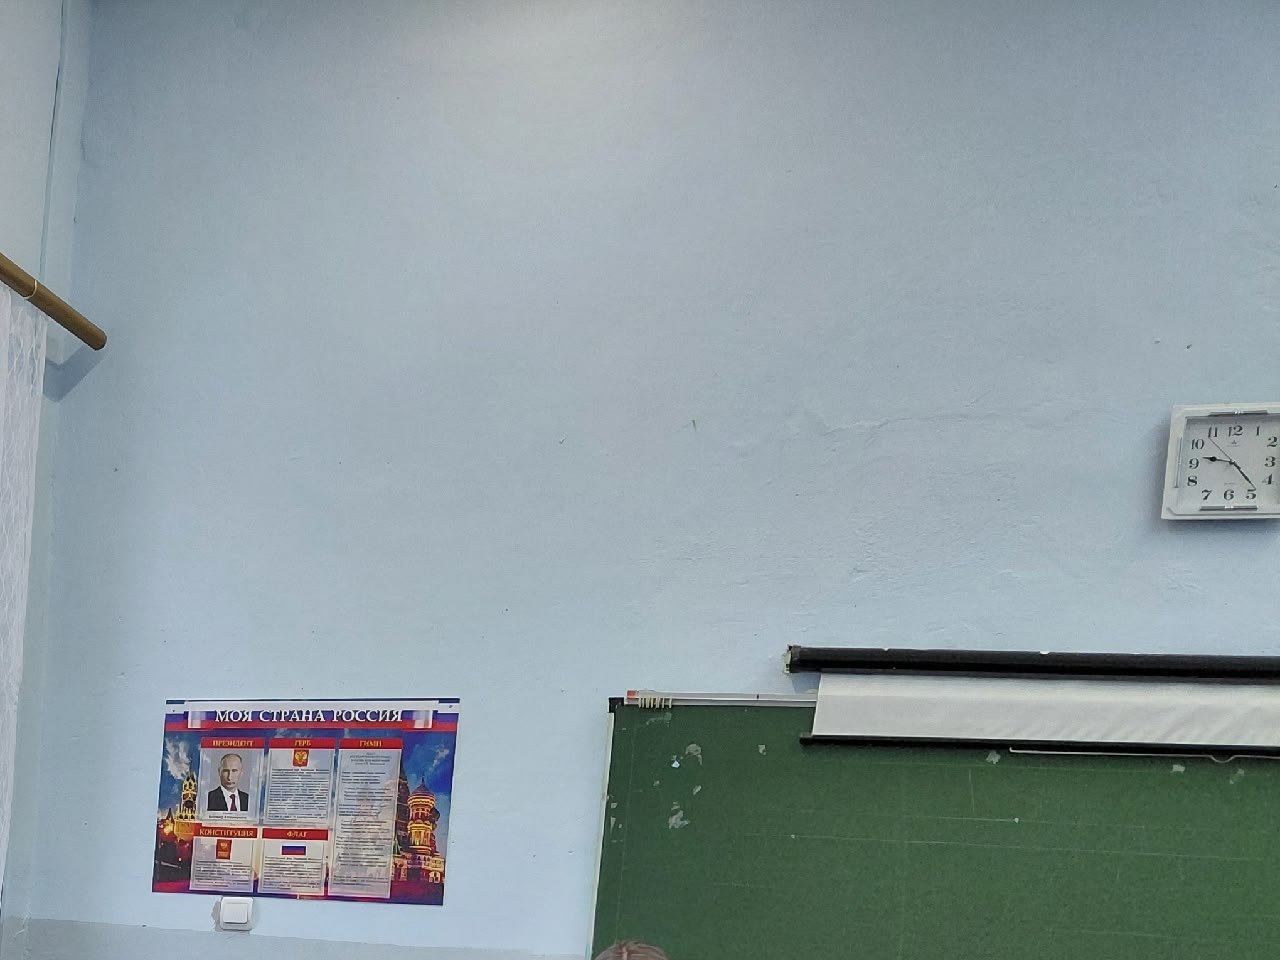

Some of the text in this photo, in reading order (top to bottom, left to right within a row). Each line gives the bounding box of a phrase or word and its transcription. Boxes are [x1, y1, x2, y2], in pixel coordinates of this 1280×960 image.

[1208, 426, 1218, 438] 11
[1228, 425, 1243, 437] 12
[1256, 426, 1260, 436] 1
[1191, 438, 1205, 450] 10
[1267, 436, 1278, 448] 2
[1188, 457, 1199, 470] 9
[1264, 456, 1276, 468] 3
[1187, 475, 1198, 487] 8
[1262, 473, 1275, 485] 4
[1201, 489, 1213, 501] 7
[1223, 489, 1235, 501] 6
[1246, 488, 1257, 500] 5
[215, 709, 402, 722] МОЯ СТРАНА РОССИЯ
[359, 739, 382, 748] ГИМН
[199, 827, 254, 837] КОНСТИТУЦИЯ
